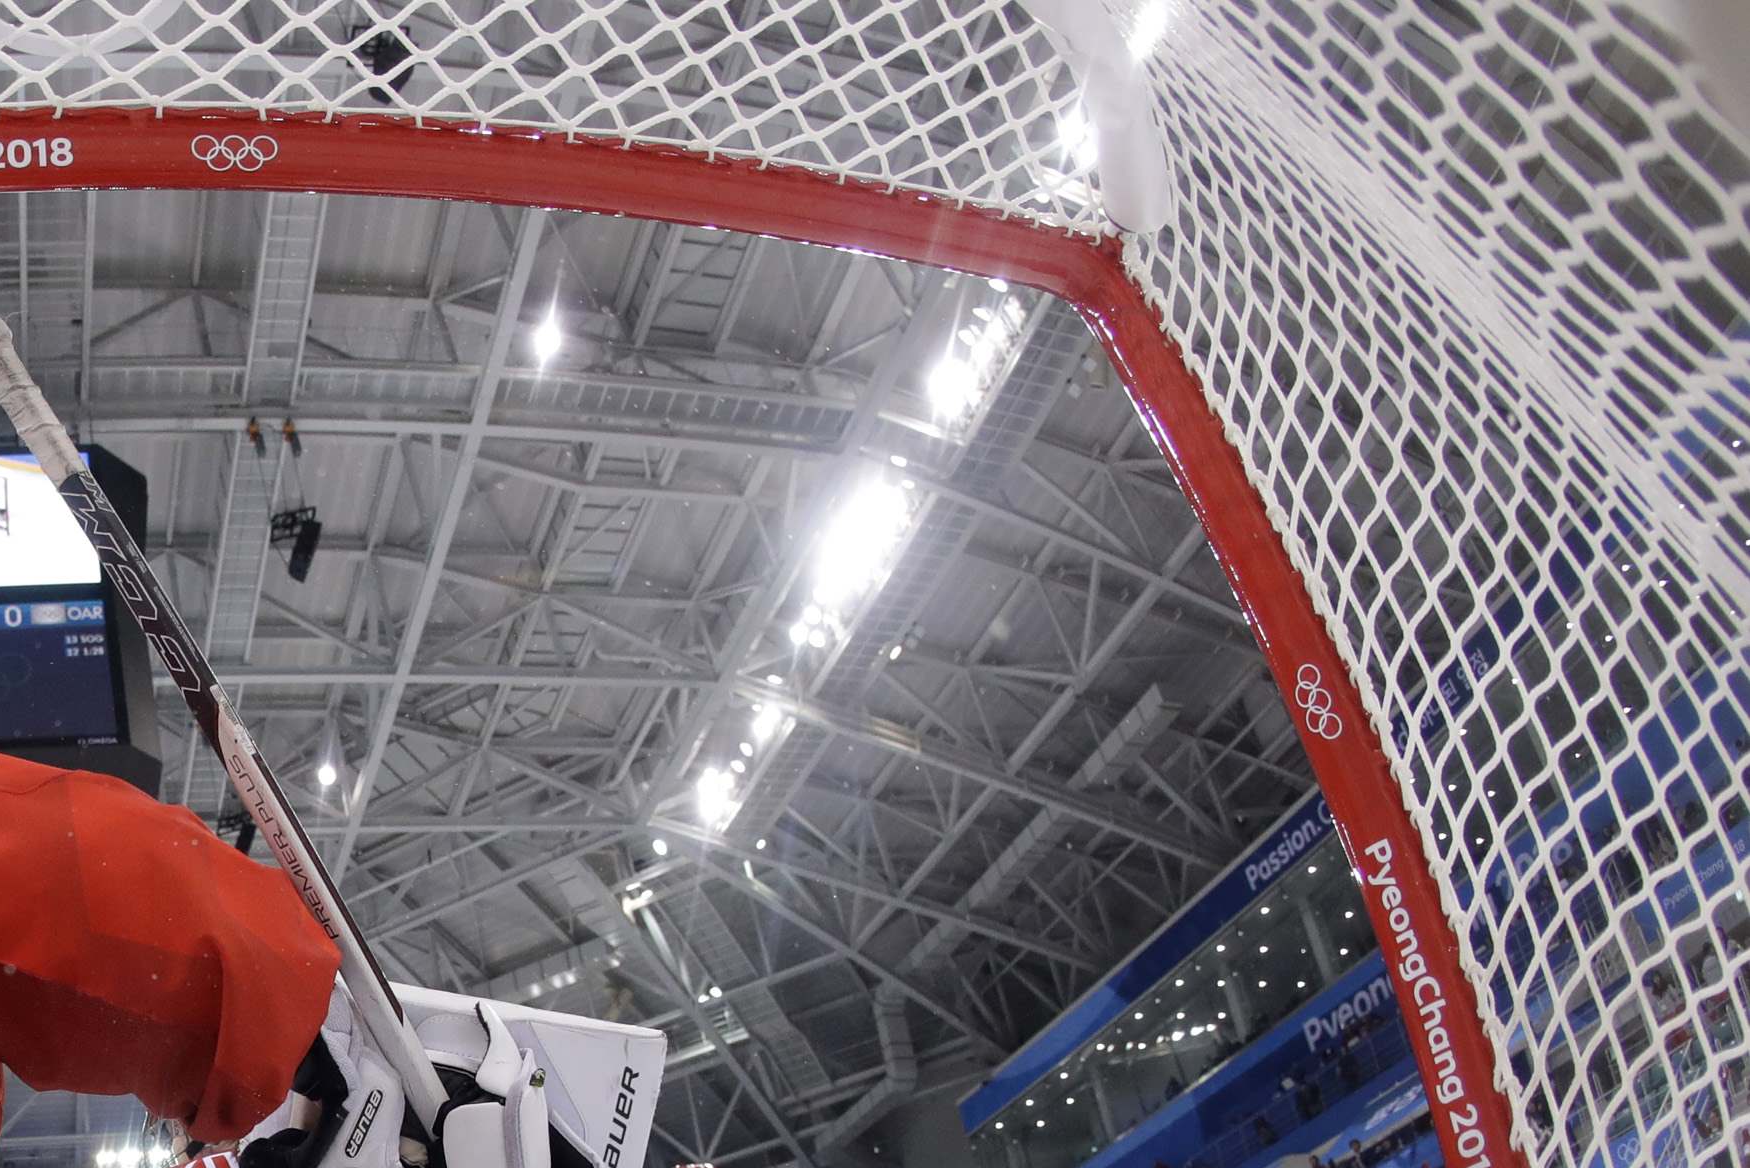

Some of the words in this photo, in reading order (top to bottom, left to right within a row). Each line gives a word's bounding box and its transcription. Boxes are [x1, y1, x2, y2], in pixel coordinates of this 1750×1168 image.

[4, 605, 23, 627] 0
[67, 605, 104, 620] OAR
[228, 754, 274, 825] PLUS
[271, 822, 340, 941] PREMIER
[1363, 838, 1465, 1105] PyeongChang
[346, 1089, 383, 1158] BAUER
